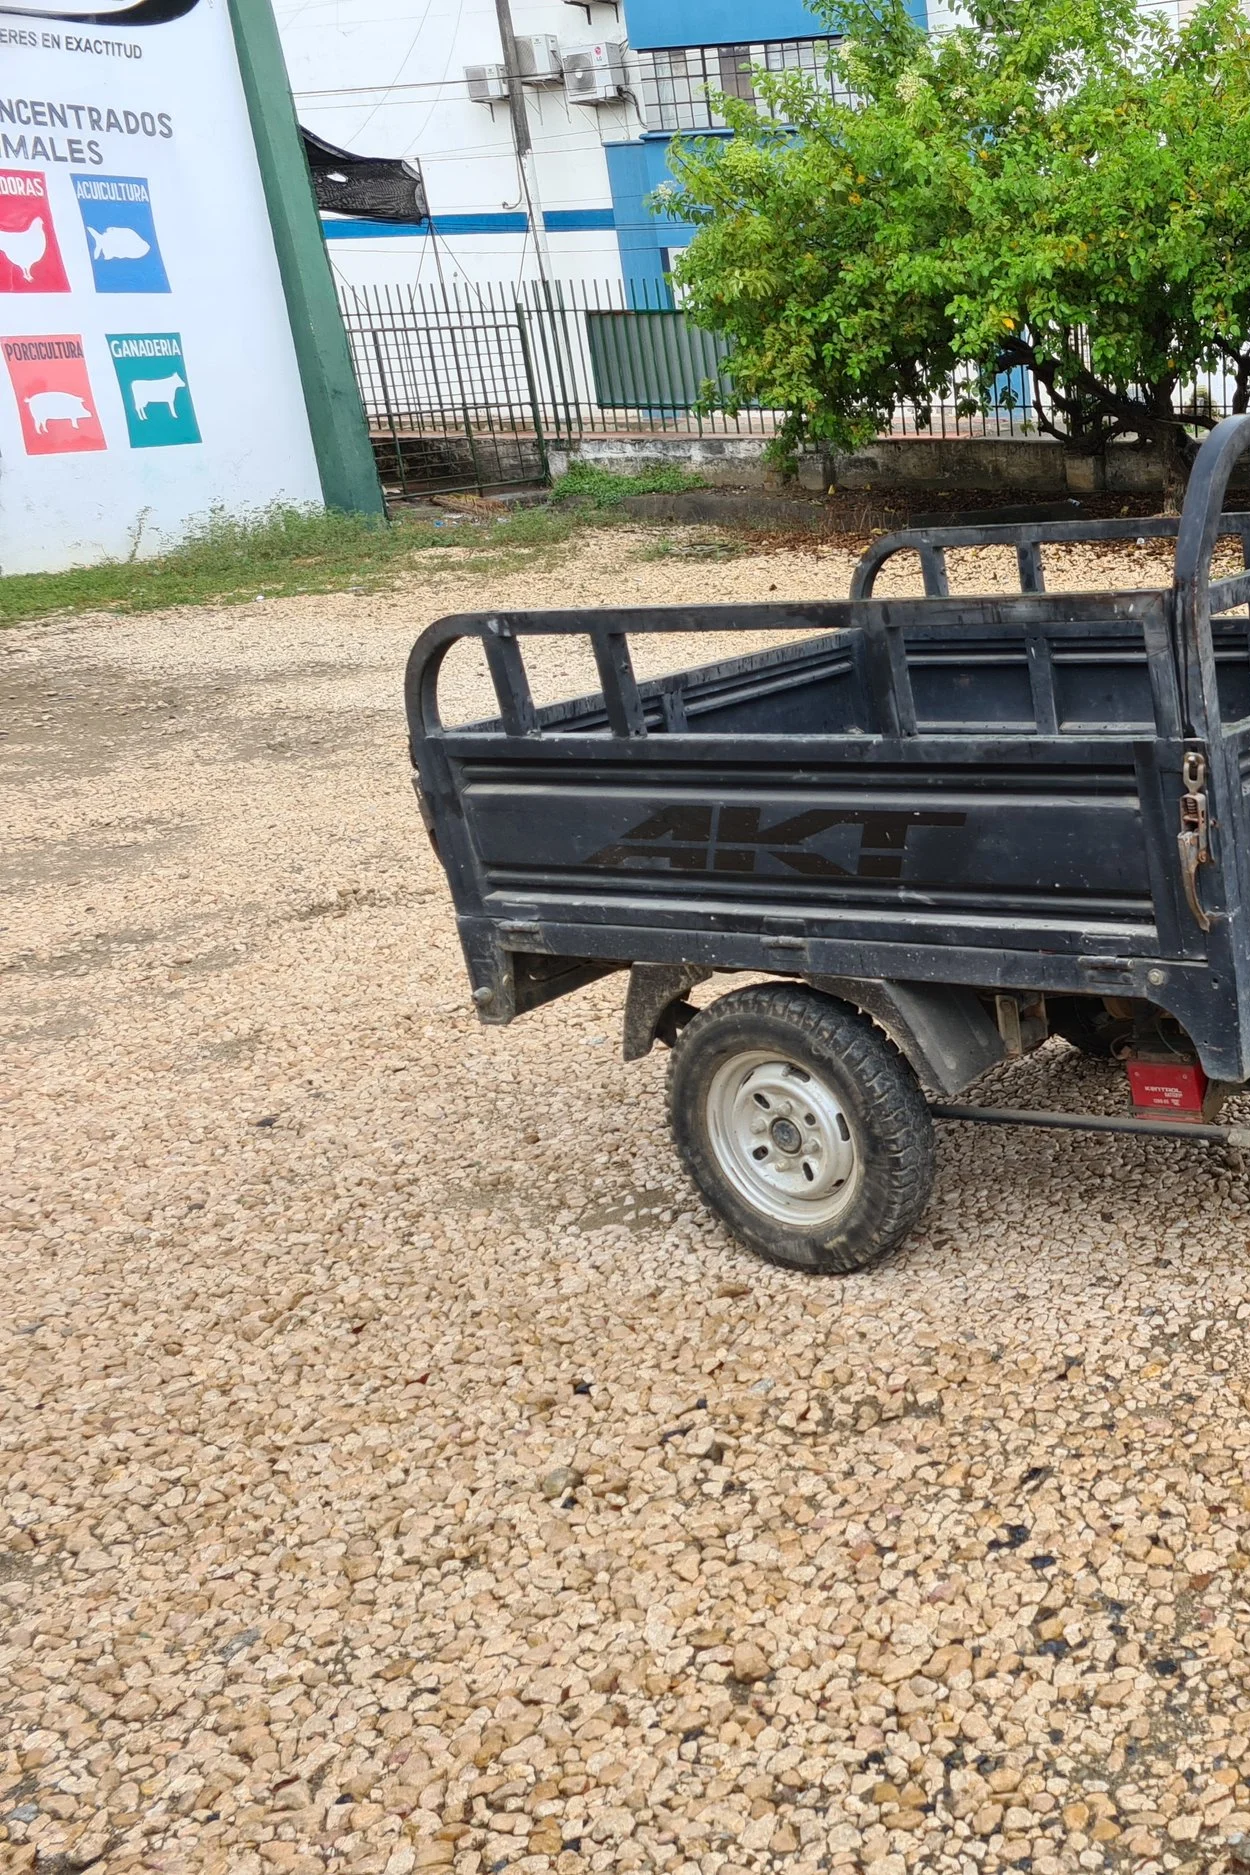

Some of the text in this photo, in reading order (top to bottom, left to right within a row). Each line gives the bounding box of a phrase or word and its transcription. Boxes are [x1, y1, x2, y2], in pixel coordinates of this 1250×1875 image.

[0, 28, 143, 59] ERES EN EXACTITUD
[0, 98, 173, 139] NCENTRADOS
[0, 133, 104, 165] MALES
[76, 180, 149, 202] ACUICULTURA
[5, 340, 84, 362] PORCICULTURA
[111, 338, 182, 359] GANADERIA
[579, 804, 967, 878] AKT
